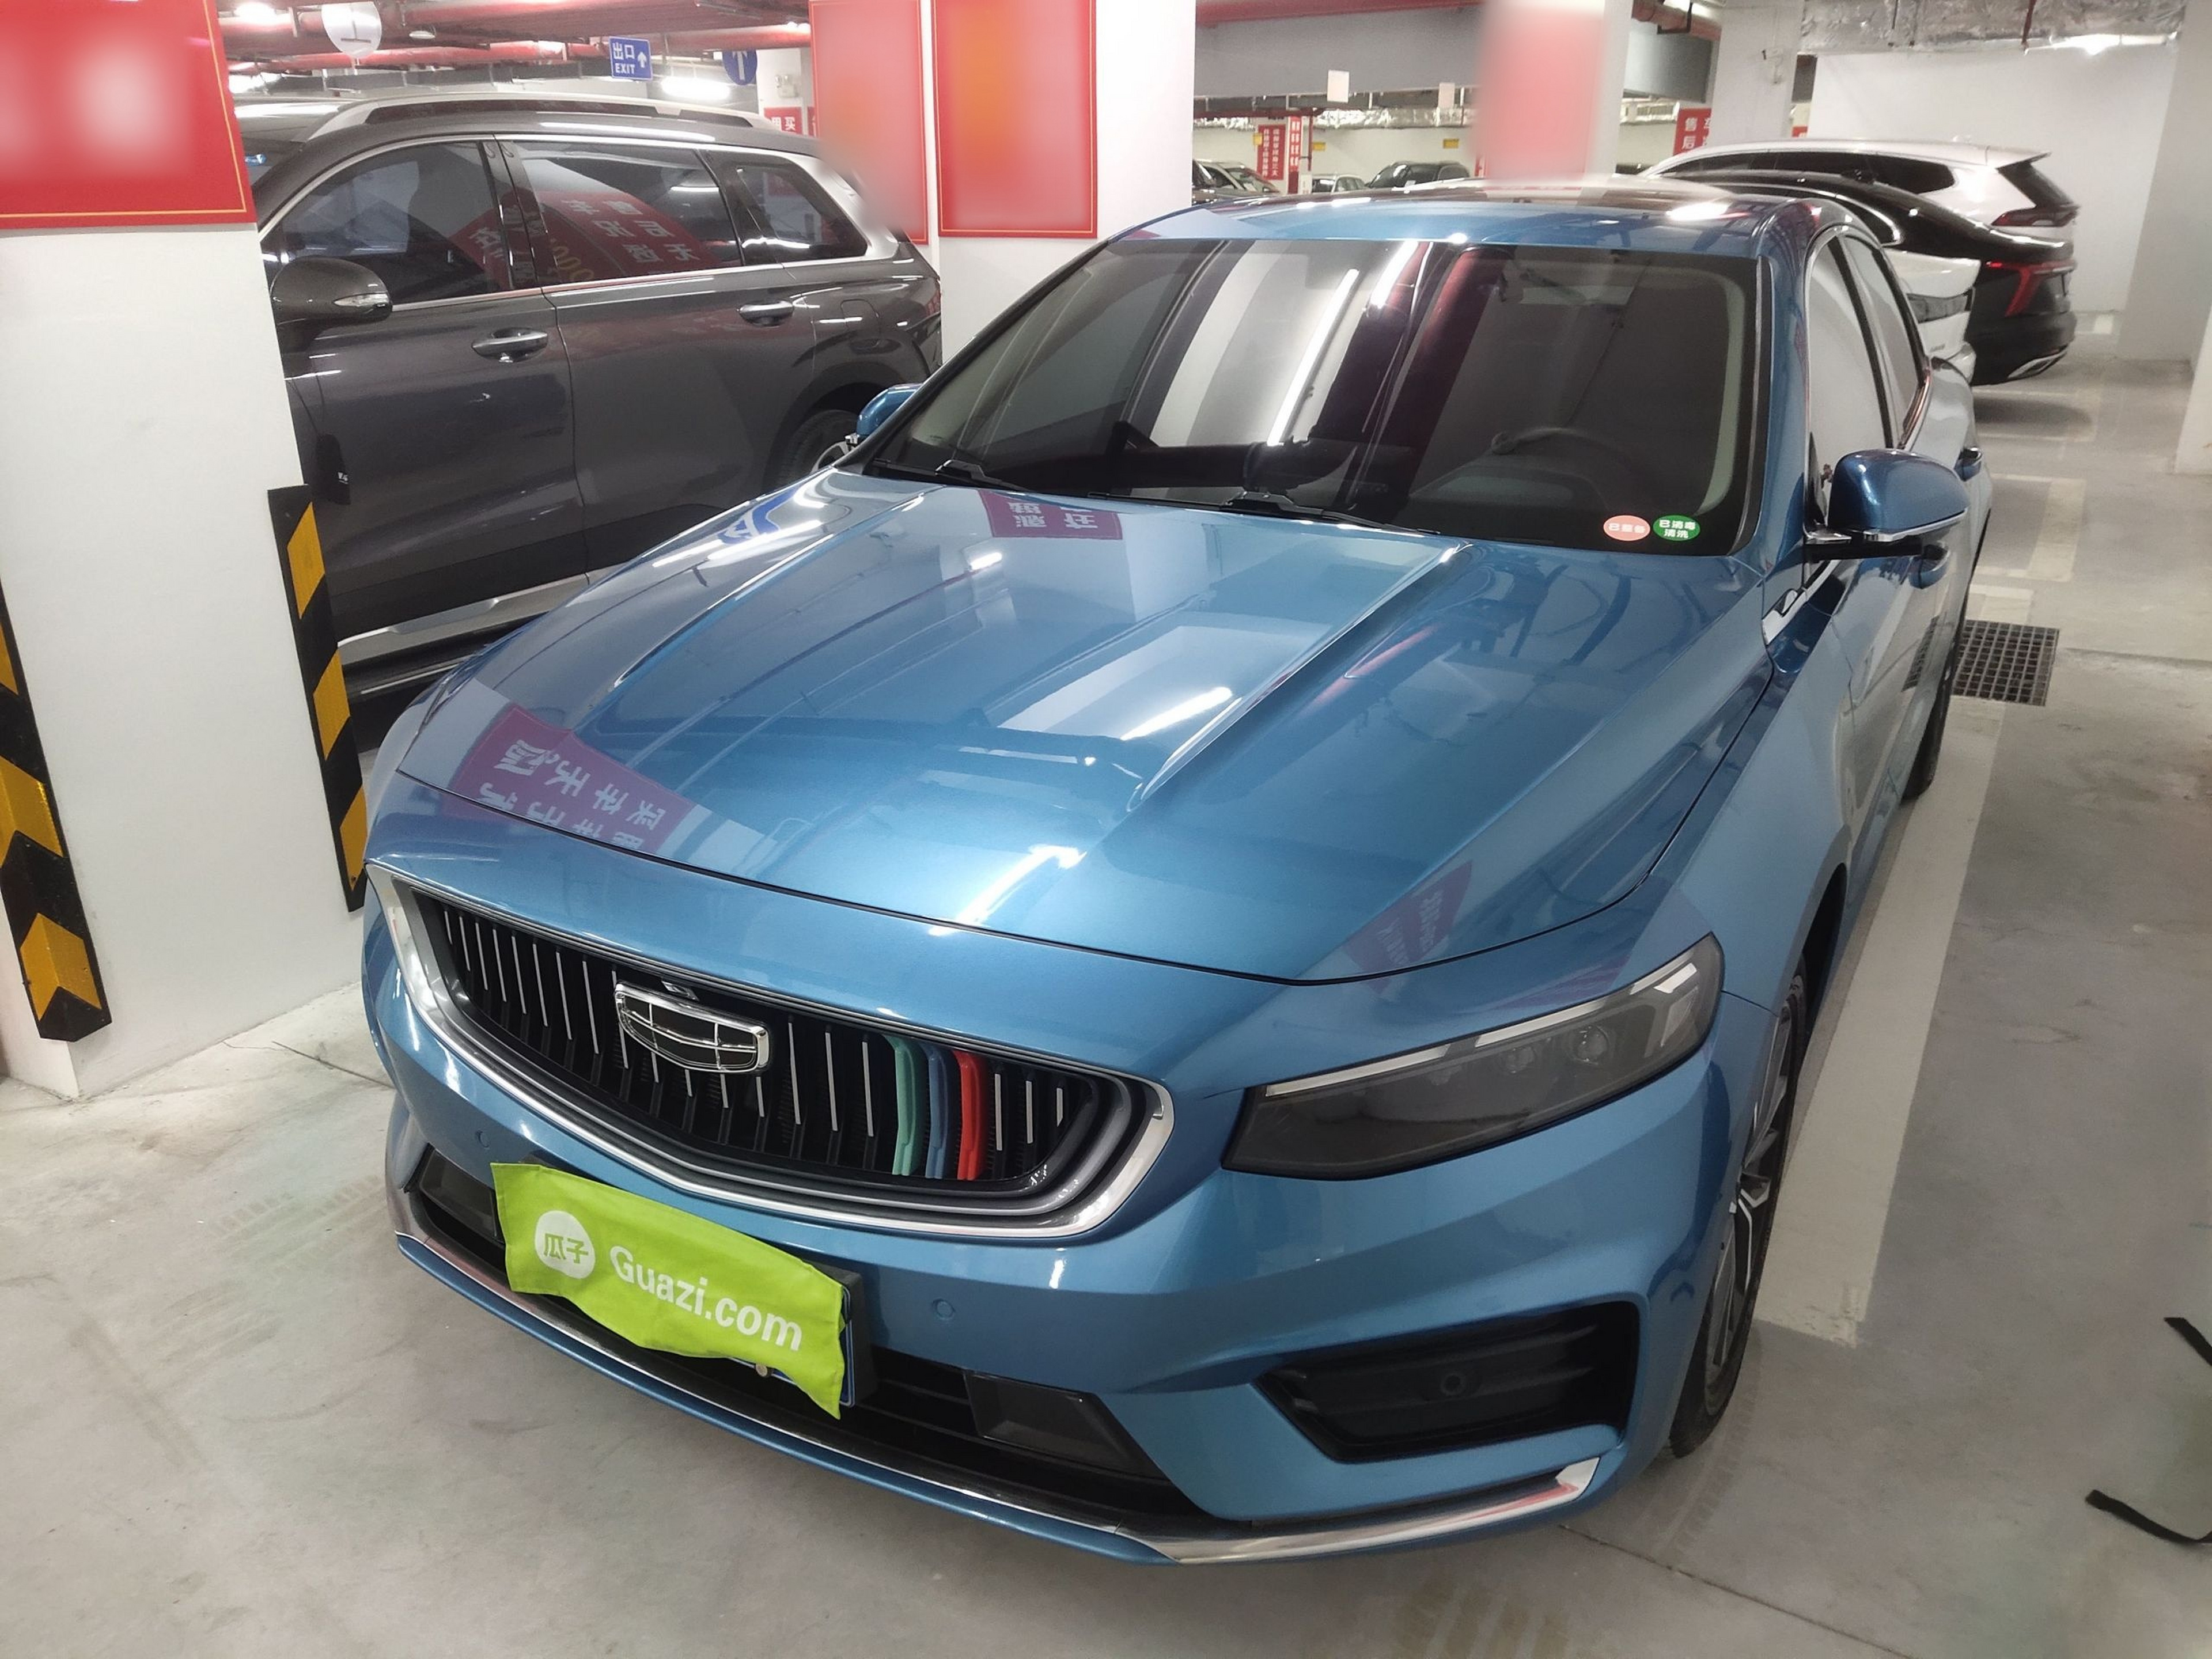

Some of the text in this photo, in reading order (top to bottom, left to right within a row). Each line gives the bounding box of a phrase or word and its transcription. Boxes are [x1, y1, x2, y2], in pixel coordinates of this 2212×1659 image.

[612, 42, 635, 60] 出口
[615, 63, 635, 74] EXIT
[1659, 520, 1696, 530] 已消毒
[1664, 528, 1689, 539] 清洗
[543, 1233, 802, 1351] 瓜子 Guazi.com
